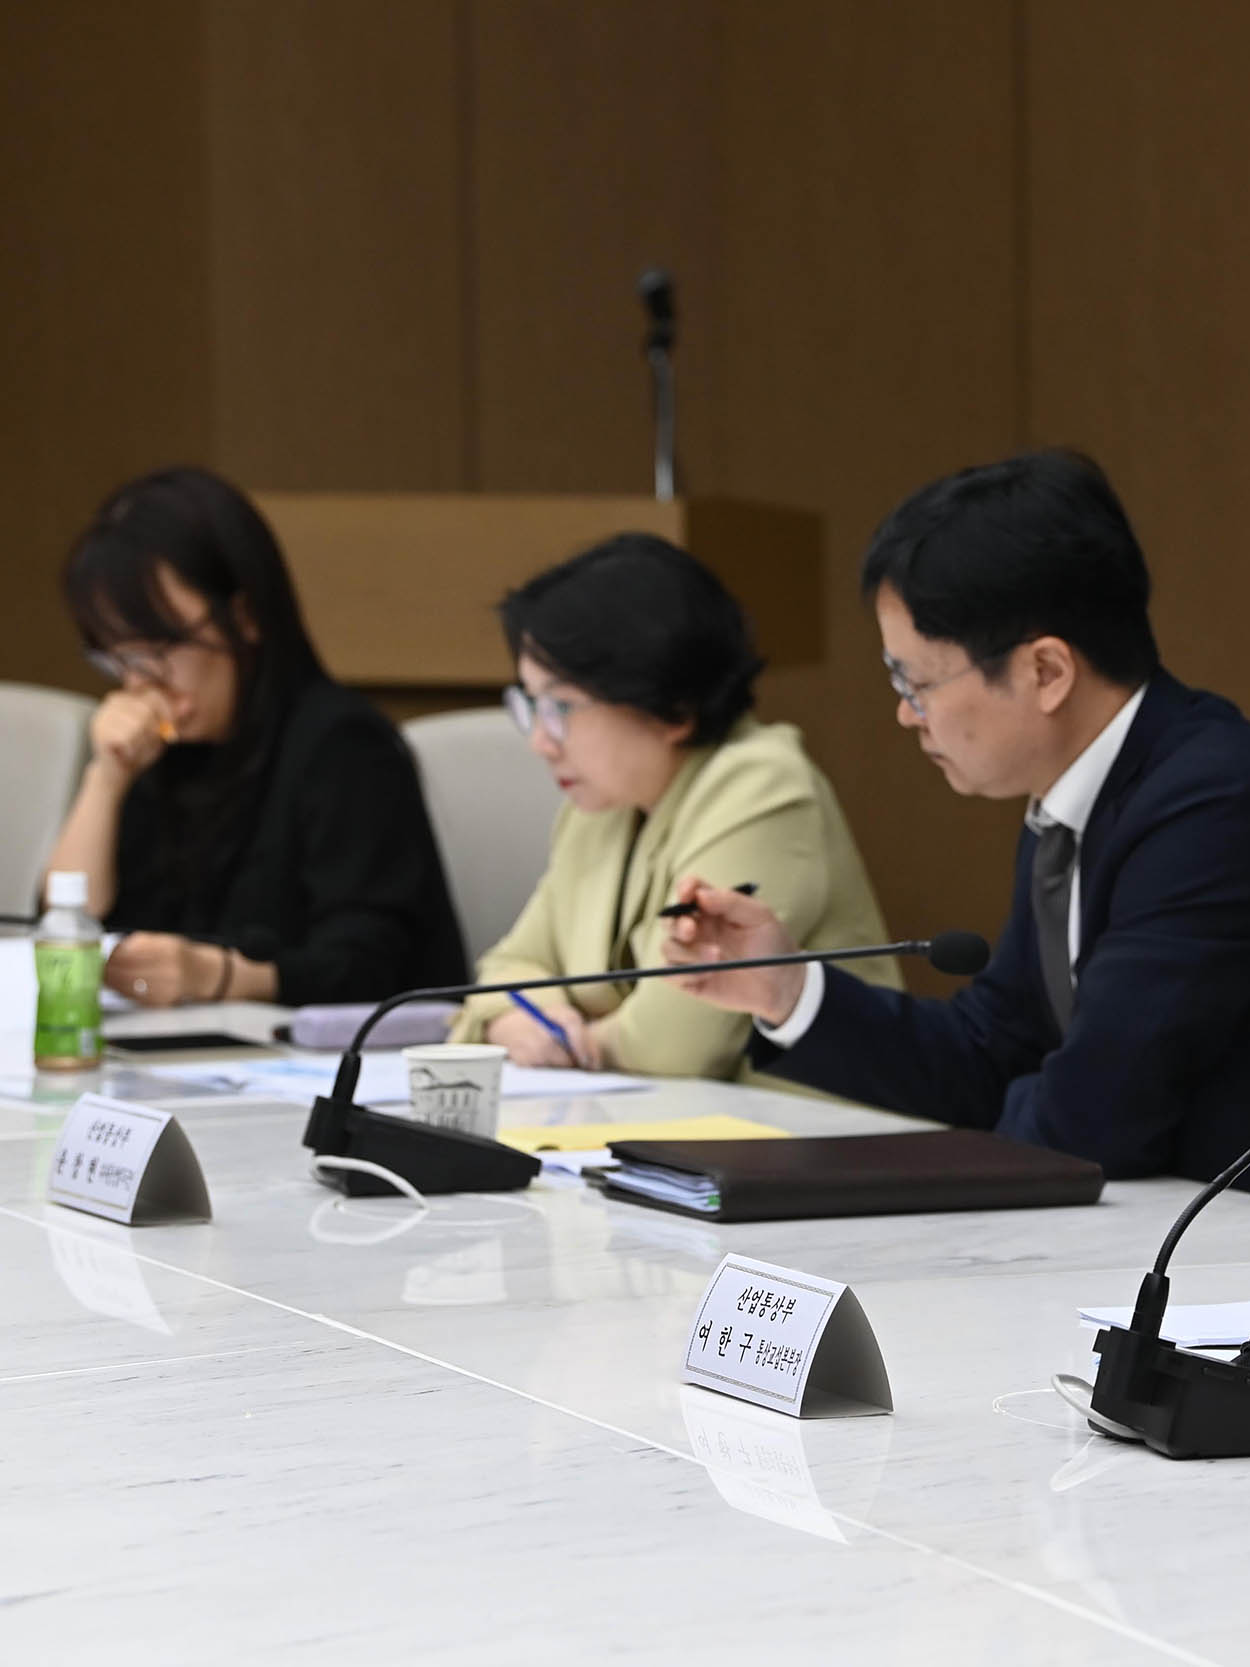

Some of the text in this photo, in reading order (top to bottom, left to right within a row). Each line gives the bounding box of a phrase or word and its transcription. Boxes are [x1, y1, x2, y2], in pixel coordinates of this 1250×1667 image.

[737, 1286, 797, 1324] 산업통상부
[699, 1319, 803, 1376] 여 한 구 통상교섭본부장
